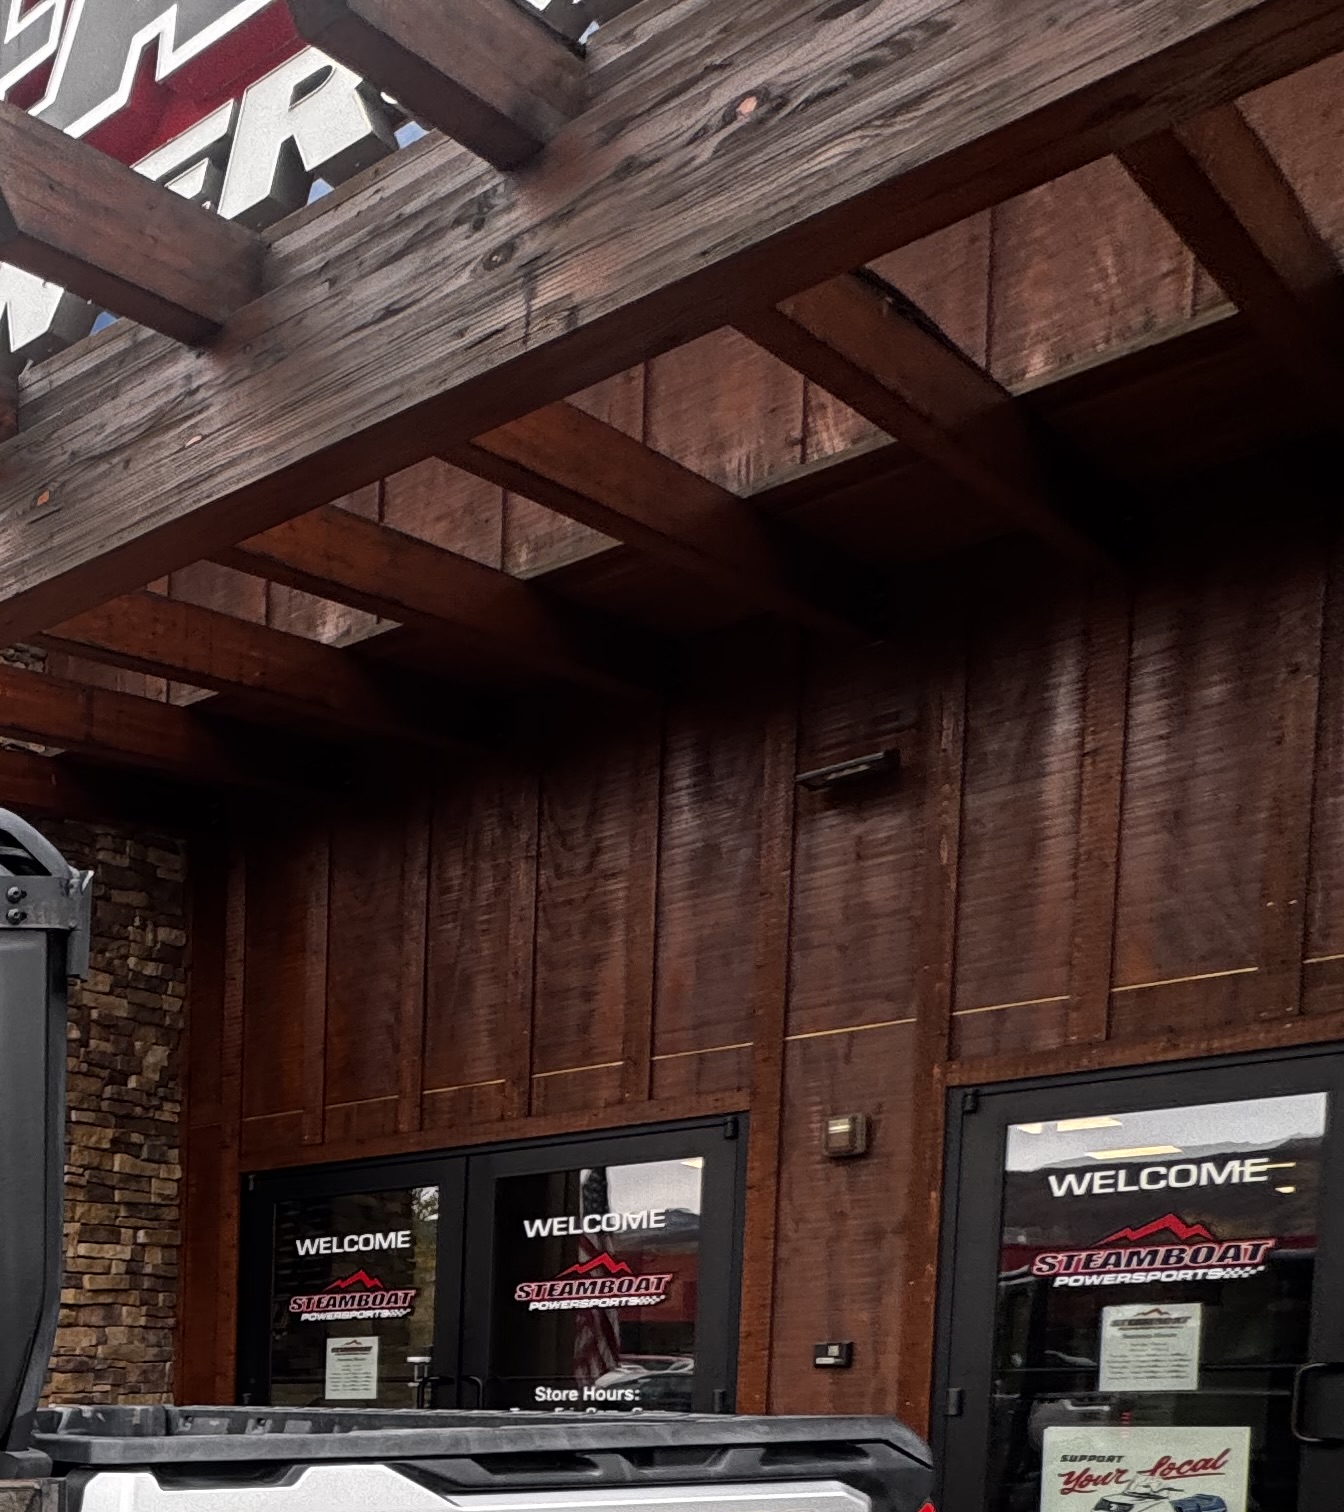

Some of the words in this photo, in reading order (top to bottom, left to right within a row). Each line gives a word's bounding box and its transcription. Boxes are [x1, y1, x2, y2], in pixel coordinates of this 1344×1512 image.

[1048, 1158, 1270, 1197] WELCOME
[523, 1209, 667, 1238] WELCOME
[295, 1230, 412, 1256] WELCOME
[1032, 1239, 1277, 1275] STEAMBOAT
[514, 1273, 674, 1301] STEAMBOAT
[1053, 1267, 1223, 1288] POWERSPORTS
[289, 1289, 417, 1312] STEAMBOAT
[528, 1297, 639, 1311] POWERSPORTS
[300, 1309, 389, 1321] POWERSPORTS
[534, 1386, 579, 1402] Store
[583, 1386, 641, 1402] Hours:
[1060, 1454, 1126, 1463] SUPPORT
[1058, 1467, 1132, 1495] Your
